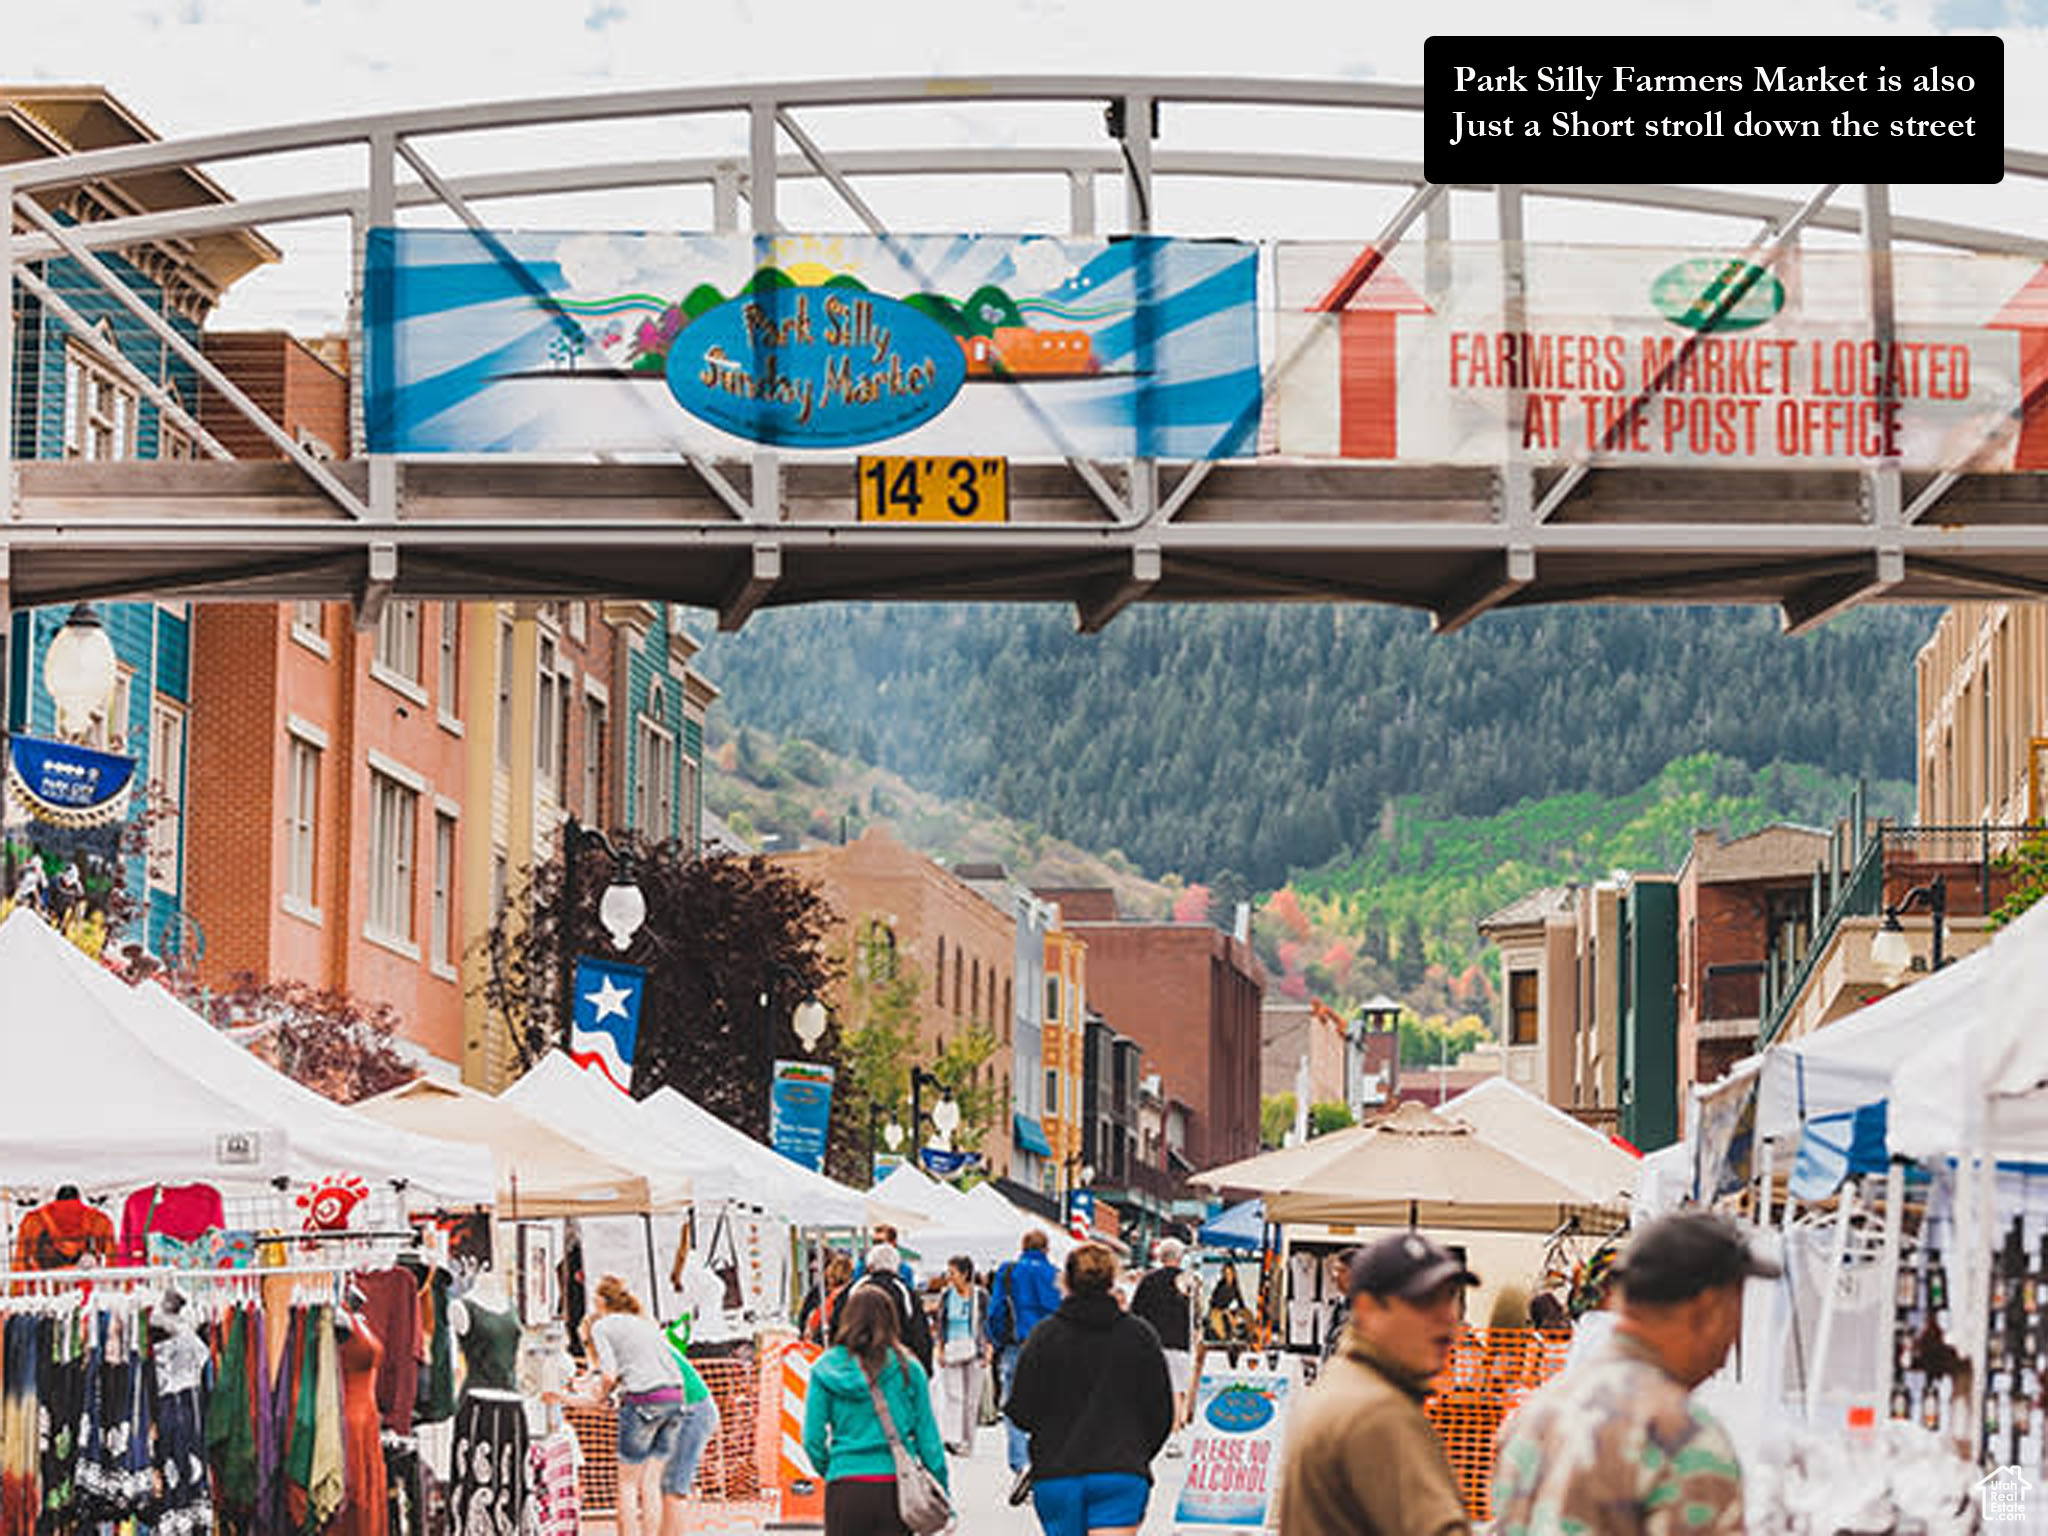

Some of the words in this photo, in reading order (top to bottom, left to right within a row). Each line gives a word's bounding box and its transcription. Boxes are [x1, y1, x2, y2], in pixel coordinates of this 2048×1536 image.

[743, 293, 814, 348] Park
[823, 294, 891, 363] Silly
[700, 345, 813, 424] Sunday
[819, 354, 936, 409] Market
[1449, 331, 1626, 392] FARMERS
[1641, 335, 1797, 396] MARKET
[1812, 338, 1971, 400] LOCATED
[1522, 392, 1566, 450] AT
[1580, 394, 1650, 453] THE
[1663, 396, 1762, 456] POST
[1776, 398, 1904, 458] OFFICE
[867, 460, 933, 516] 14'
[947, 460, 999, 516] 3"
[1186, 1464, 1267, 1492] ALCOHOL
[1190, 1439, 1245, 1463] PLEASE
[1249, 1439, 1271, 1464] NO
